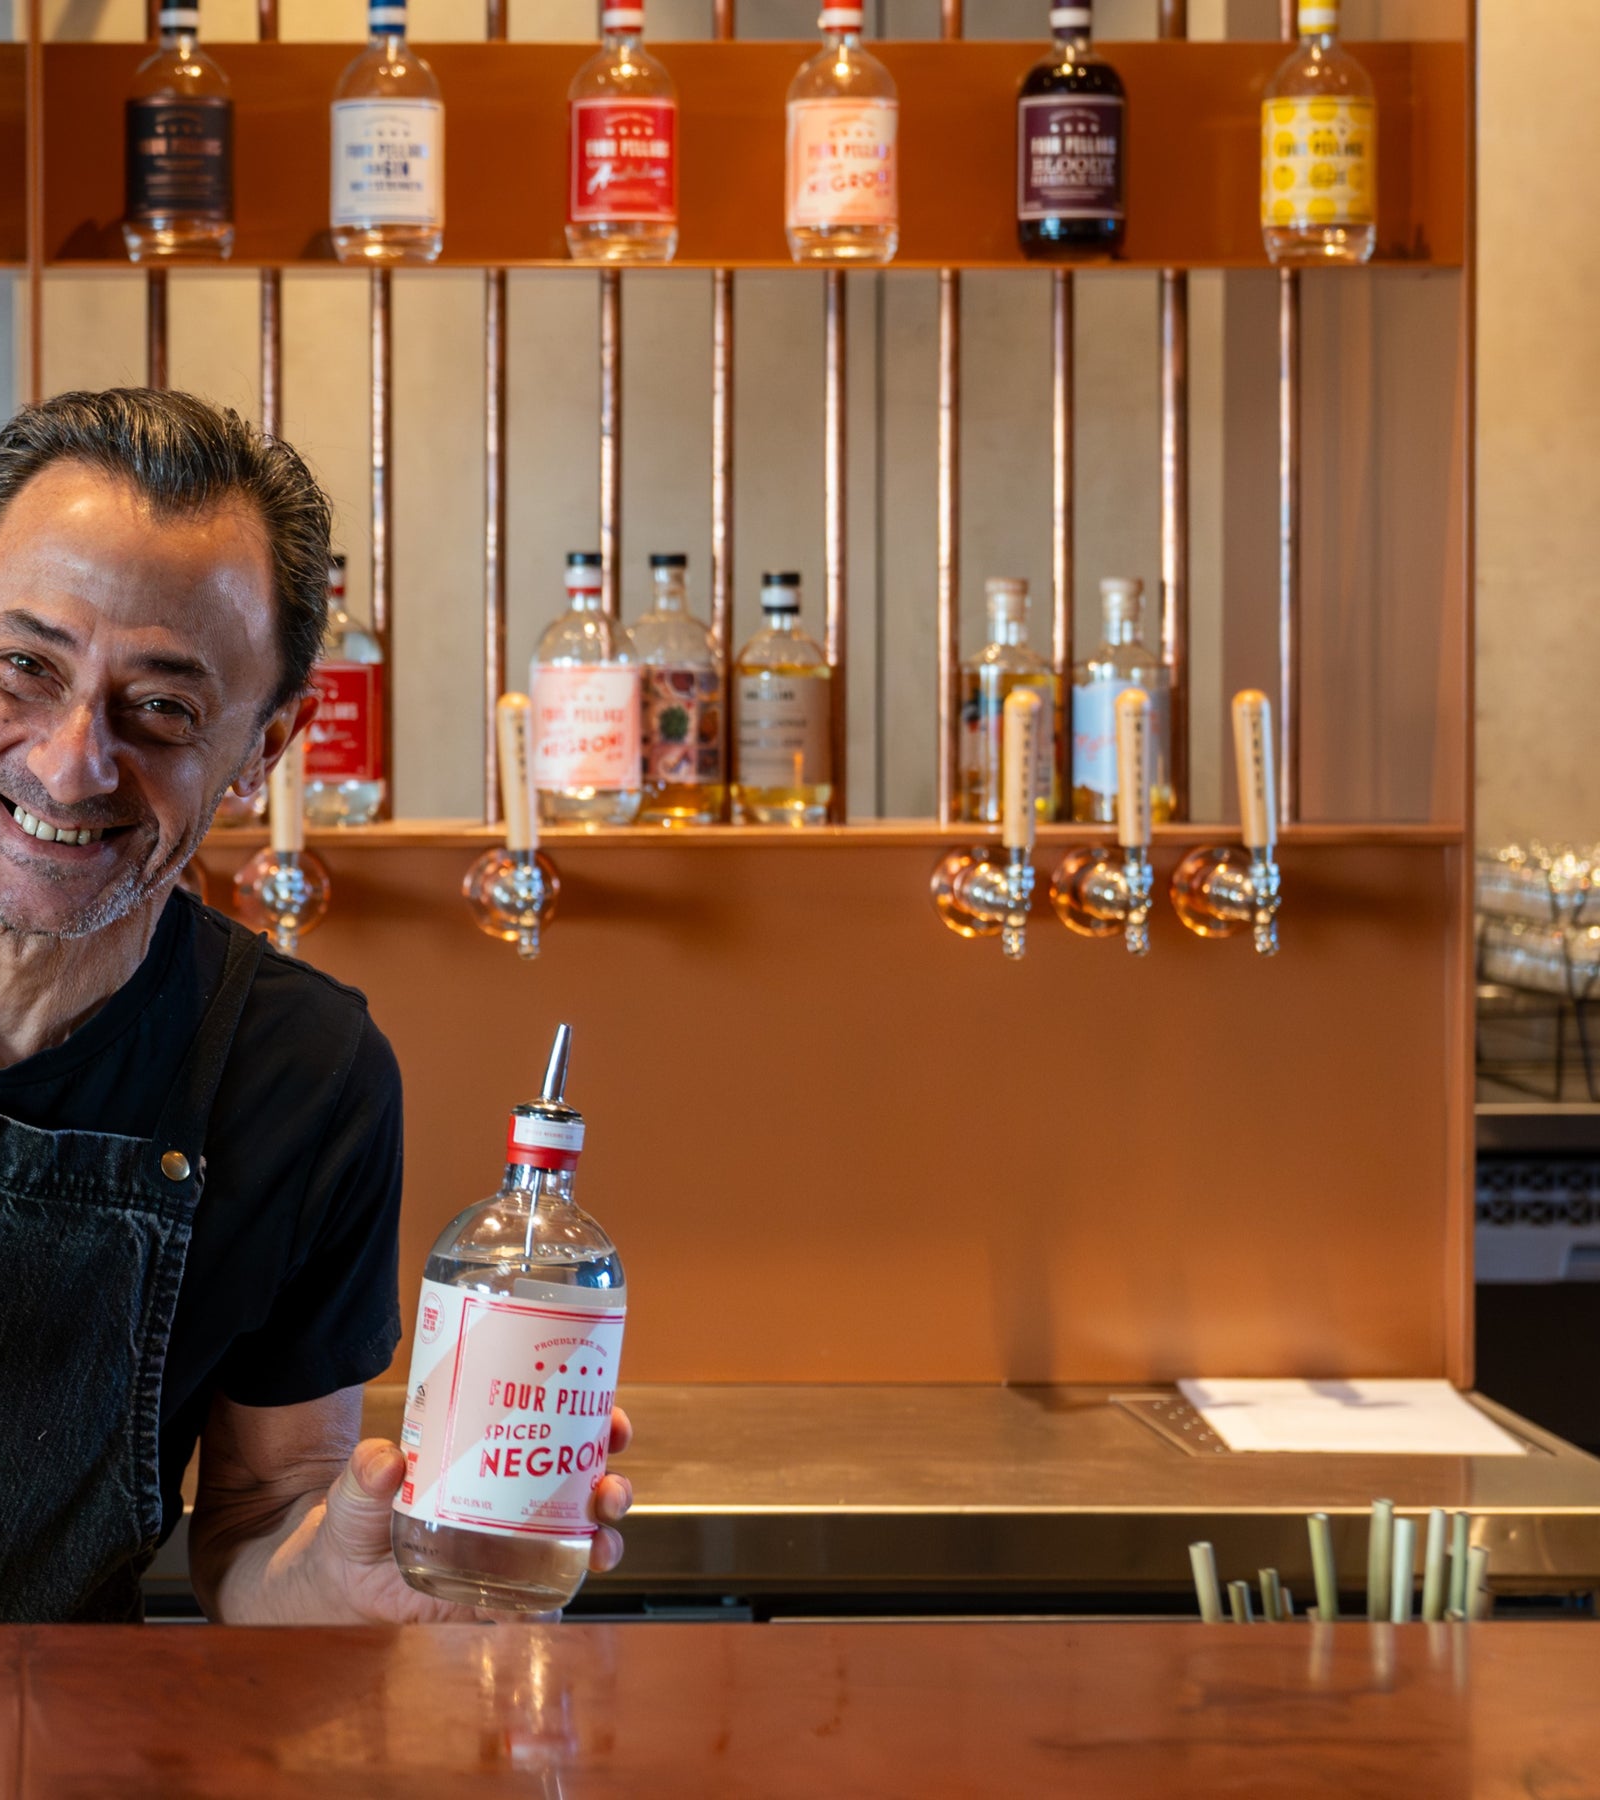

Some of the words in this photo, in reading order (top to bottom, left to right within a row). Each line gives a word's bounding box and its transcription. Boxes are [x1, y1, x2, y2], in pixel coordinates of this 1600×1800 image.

[533, 1337, 577, 1352] PROUDLY
[489, 1378, 546, 1413] FOUR
[485, 1423, 551, 1441] SPICED
[479, 1436, 608, 1478] NEGRON
